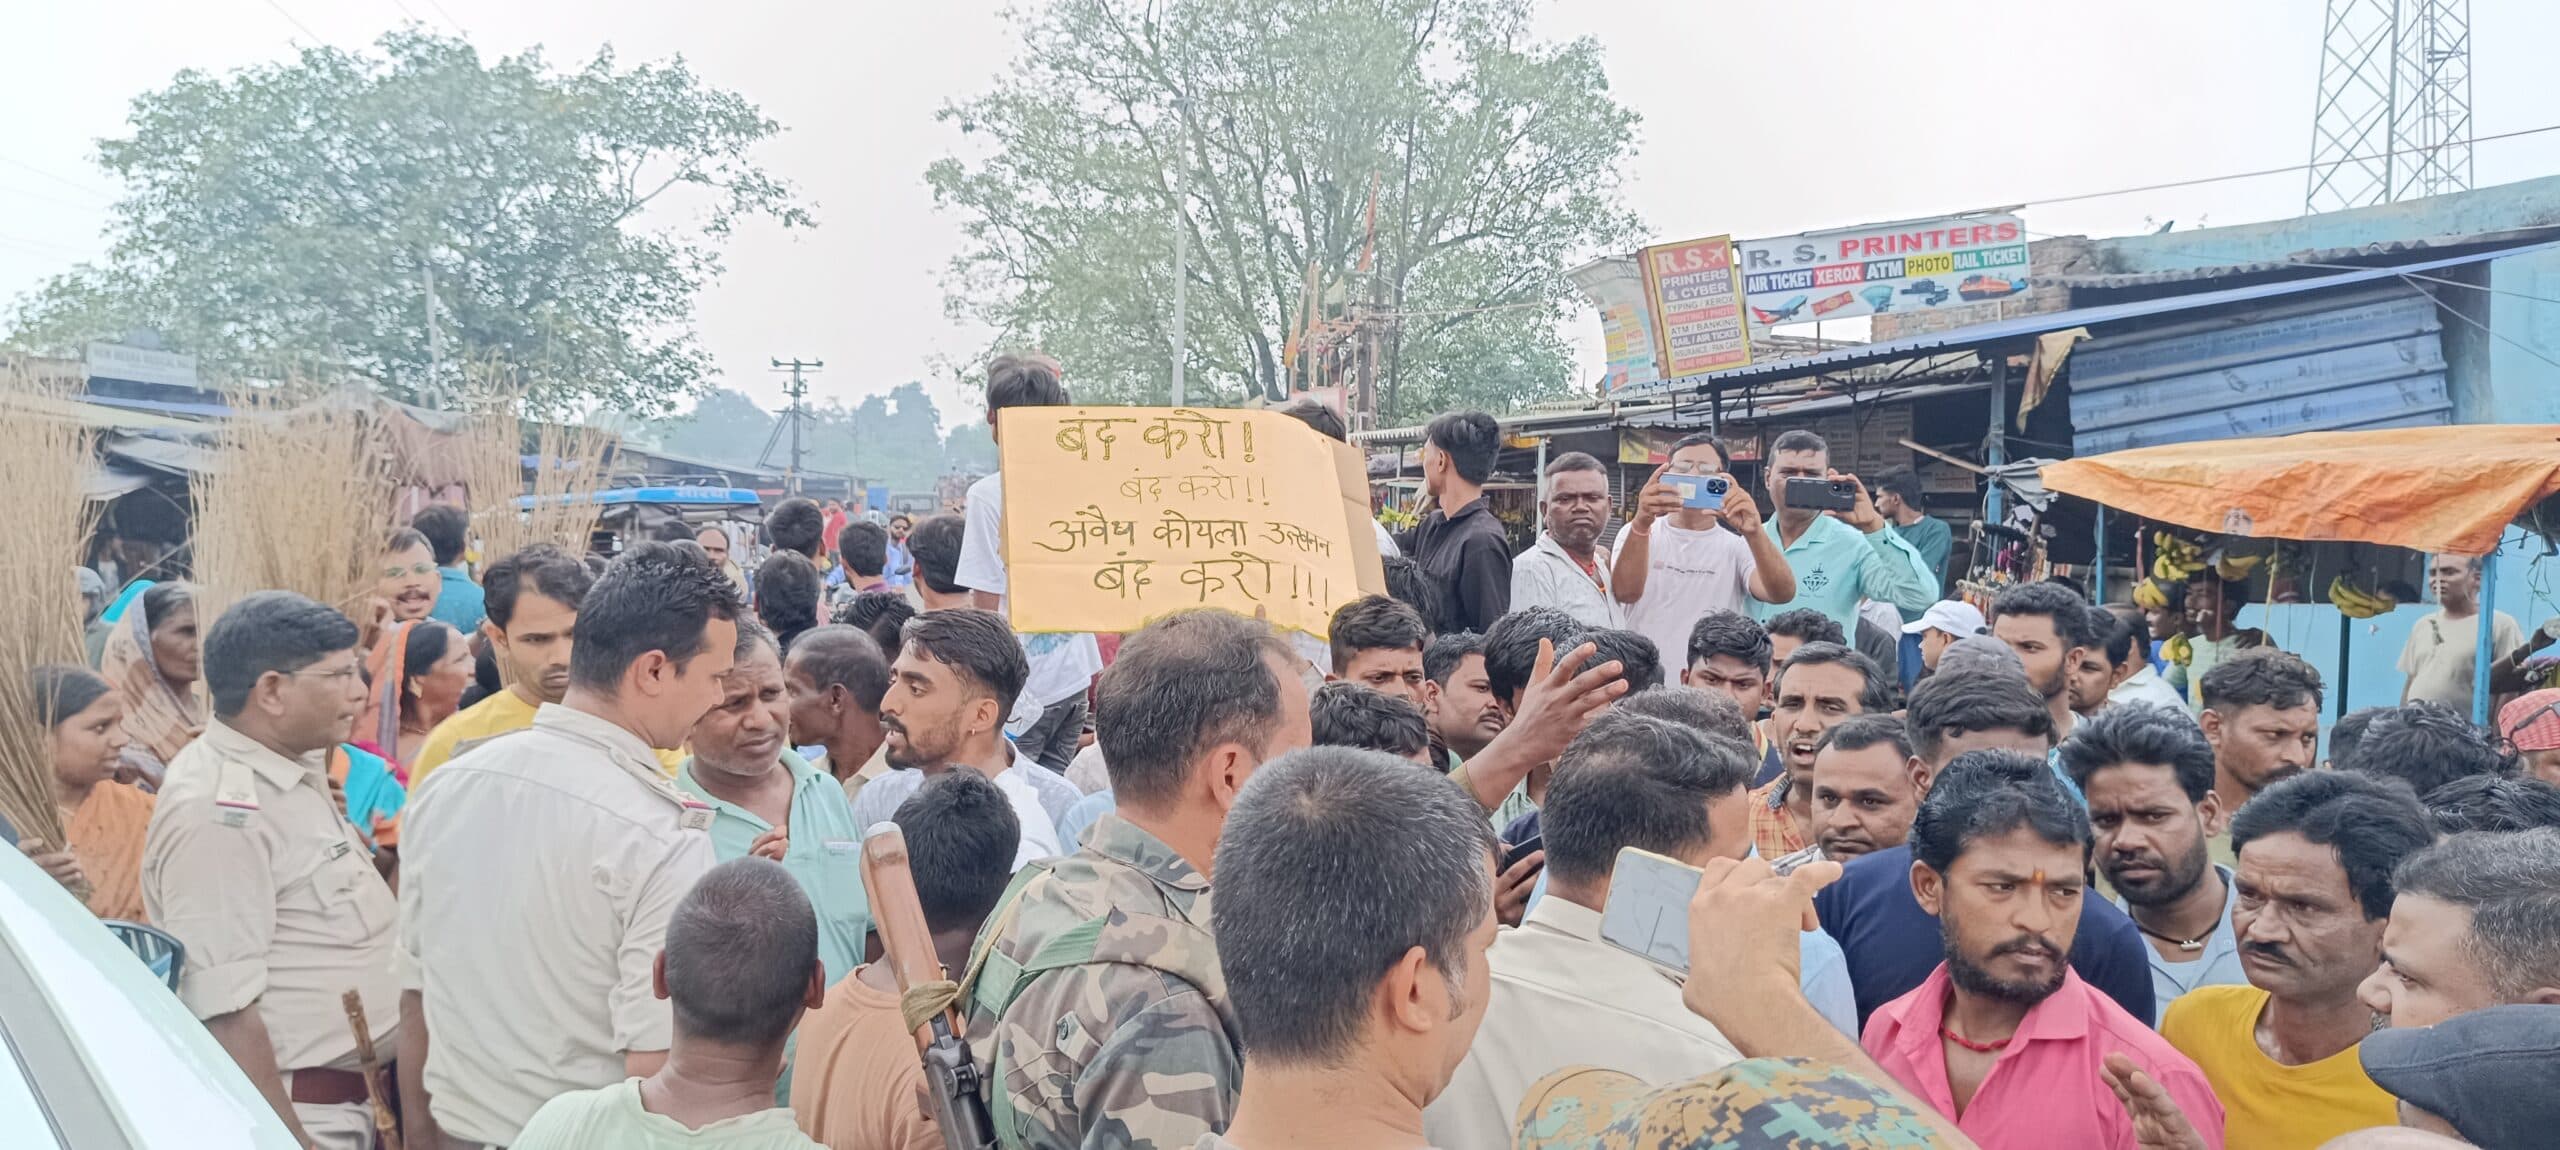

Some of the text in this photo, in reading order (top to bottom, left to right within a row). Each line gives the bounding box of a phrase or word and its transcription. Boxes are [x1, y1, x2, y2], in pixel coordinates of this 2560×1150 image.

[1655, 247, 1709, 274] R.S.
[1747, 222, 2019, 270] R. S. PRINTERS
[1662, 268, 1729, 289] PRINTERS
[1747, 275, 1769, 294] AIR
[1770, 269, 1813, 291] TICKET
[1815, 265, 1861, 284] XEROX
[1866, 260, 1904, 279] ATM
[1908, 256, 1950, 274] PHOTO
[1954, 252, 1979, 270] RAIL
[1667, 302, 1698, 312] TYPING
[1705, 296, 1735, 306] XEROX
[1668, 281, 1729, 300] & CYBER
[1671, 324, 1689, 335] ATM
[1697, 317, 1737, 331] BANKING
[1672, 335, 1691, 348] RAIL
[1696, 332, 1711, 344] AIR
[1711, 329, 1740, 342] TICKET
[1056, 410, 1137, 461] बंद
[1120, 468, 1172, 504] बंद
[1153, 509, 1248, 549] कोयला
[1094, 551, 1156, 600] बंद
